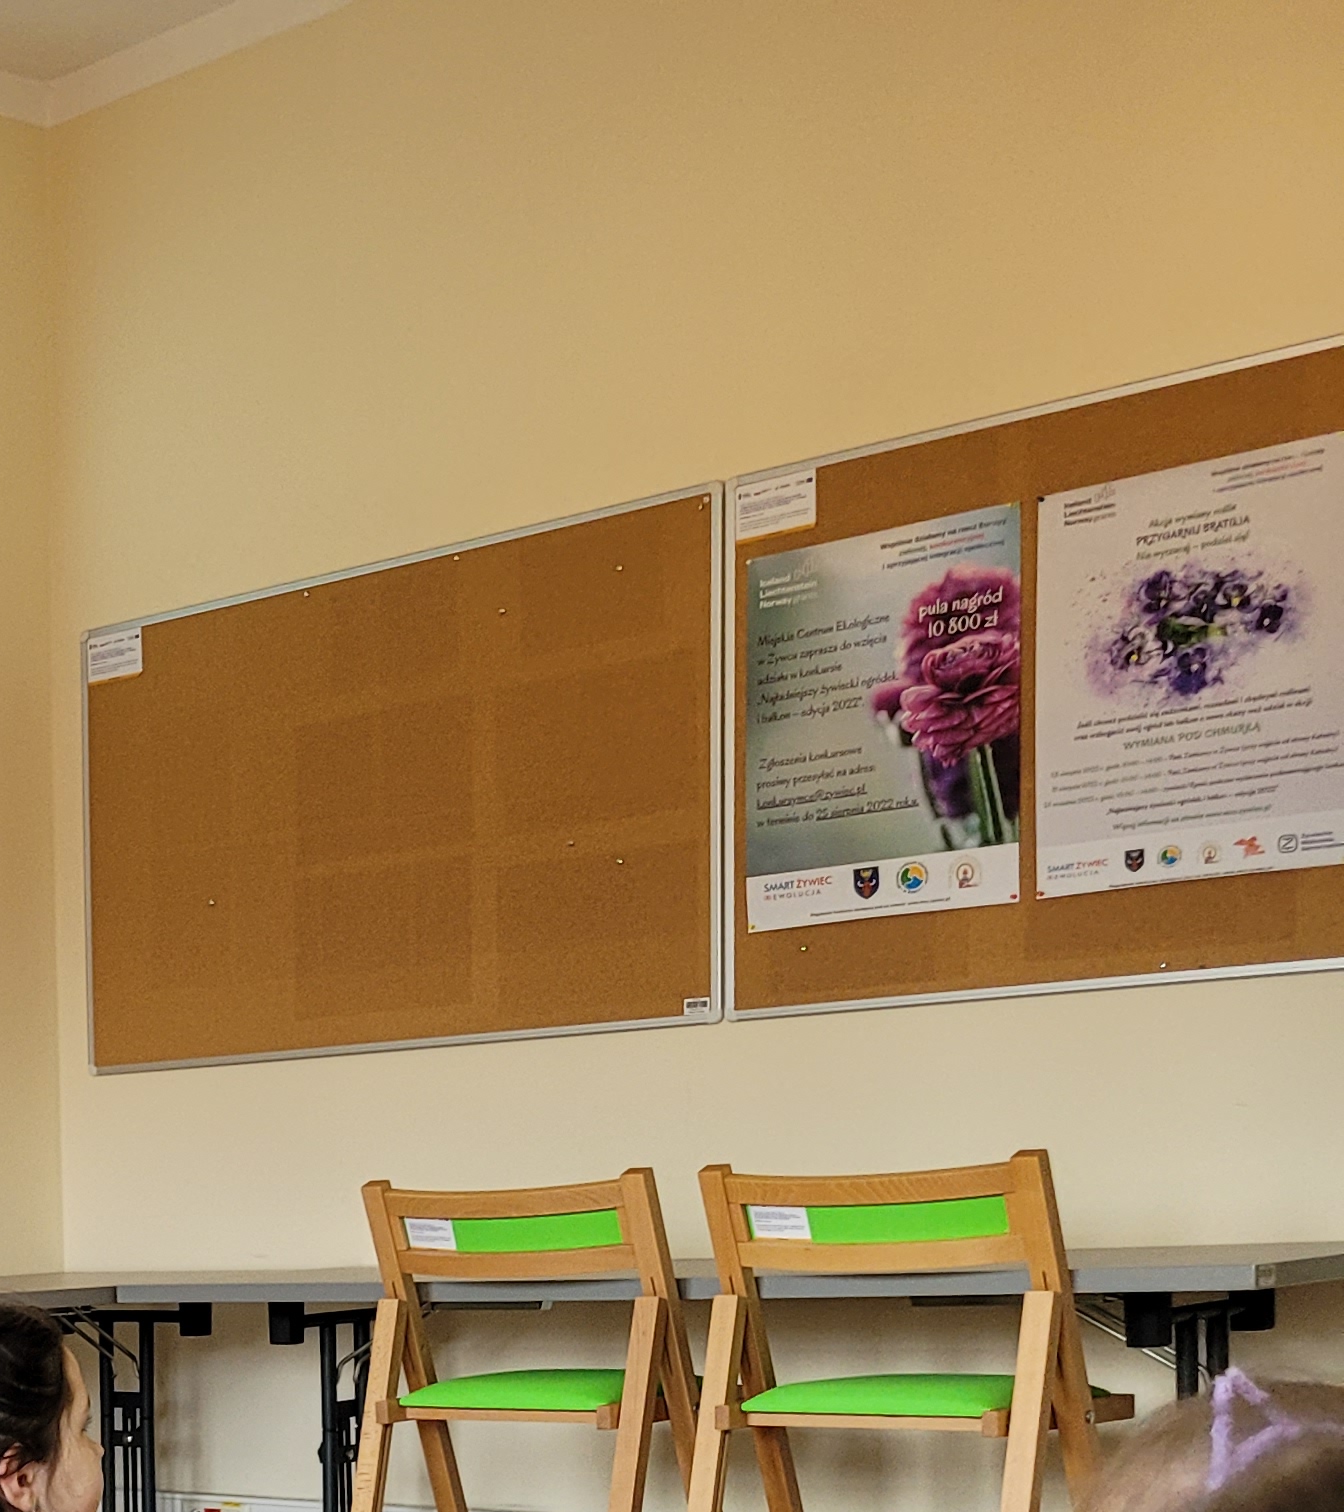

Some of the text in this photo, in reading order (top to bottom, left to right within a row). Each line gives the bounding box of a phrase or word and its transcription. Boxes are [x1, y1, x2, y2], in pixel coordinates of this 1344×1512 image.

[918, 585, 1004, 623] pula nagród
[835, 613, 891, 632] Ekologiczne
[927, 609, 999, 639] 10 800 zł
[838, 638, 853, 652] do
[864, 798, 895, 814] 2022
[764, 880, 794, 892] SMART
